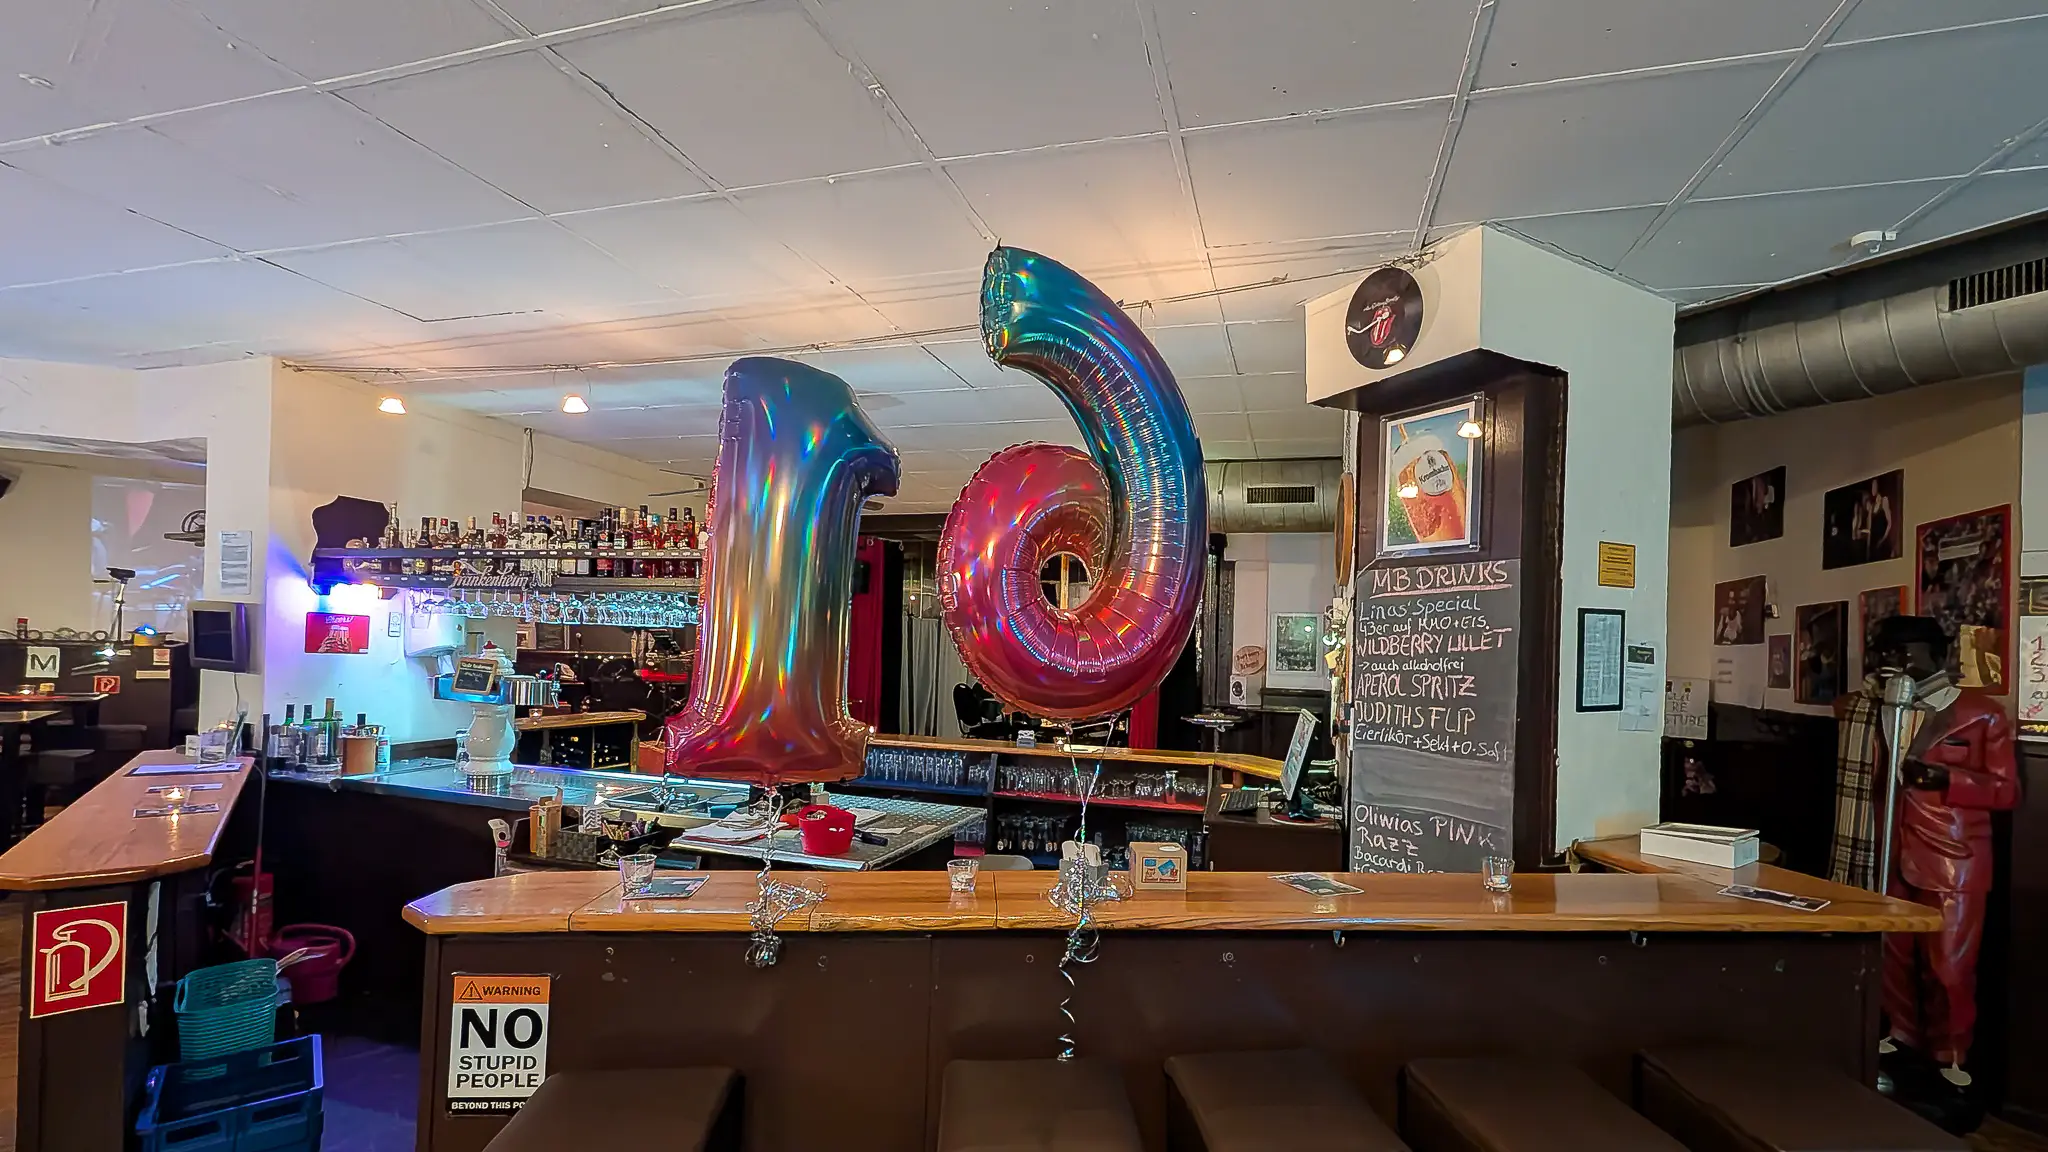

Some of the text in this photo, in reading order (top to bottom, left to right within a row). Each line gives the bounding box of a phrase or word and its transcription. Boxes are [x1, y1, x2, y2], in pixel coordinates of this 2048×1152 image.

[1372, 561, 1508, 593] MB DRINKS
[1412, 594, 1481, 619] Special
[1393, 618, 1412, 634] auf
[1356, 628, 1512, 657] WILDBERRY LILLET
[30, 654, 57, 671] M
[1371, 659, 1400, 671] auch
[1356, 673, 1478, 701] APEROL SPRITZ
[1354, 700, 1476, 735] JUDITHS FLIP
[1354, 804, 1423, 836] Oliwias
[1429, 815, 1496, 850] PINK
[1356, 826, 1418, 857] Razz
[1354, 845, 1411, 873] Bacardi
[482, 986, 541, 996] WARNING
[460, 1008, 543, 1050] NO
[458, 1055, 537, 1070] STUPID
[456, 1073, 539, 1088] PEOPLE
[451, 1101, 489, 1109] BEYOND
[490, 1101, 511, 1109] THIS
